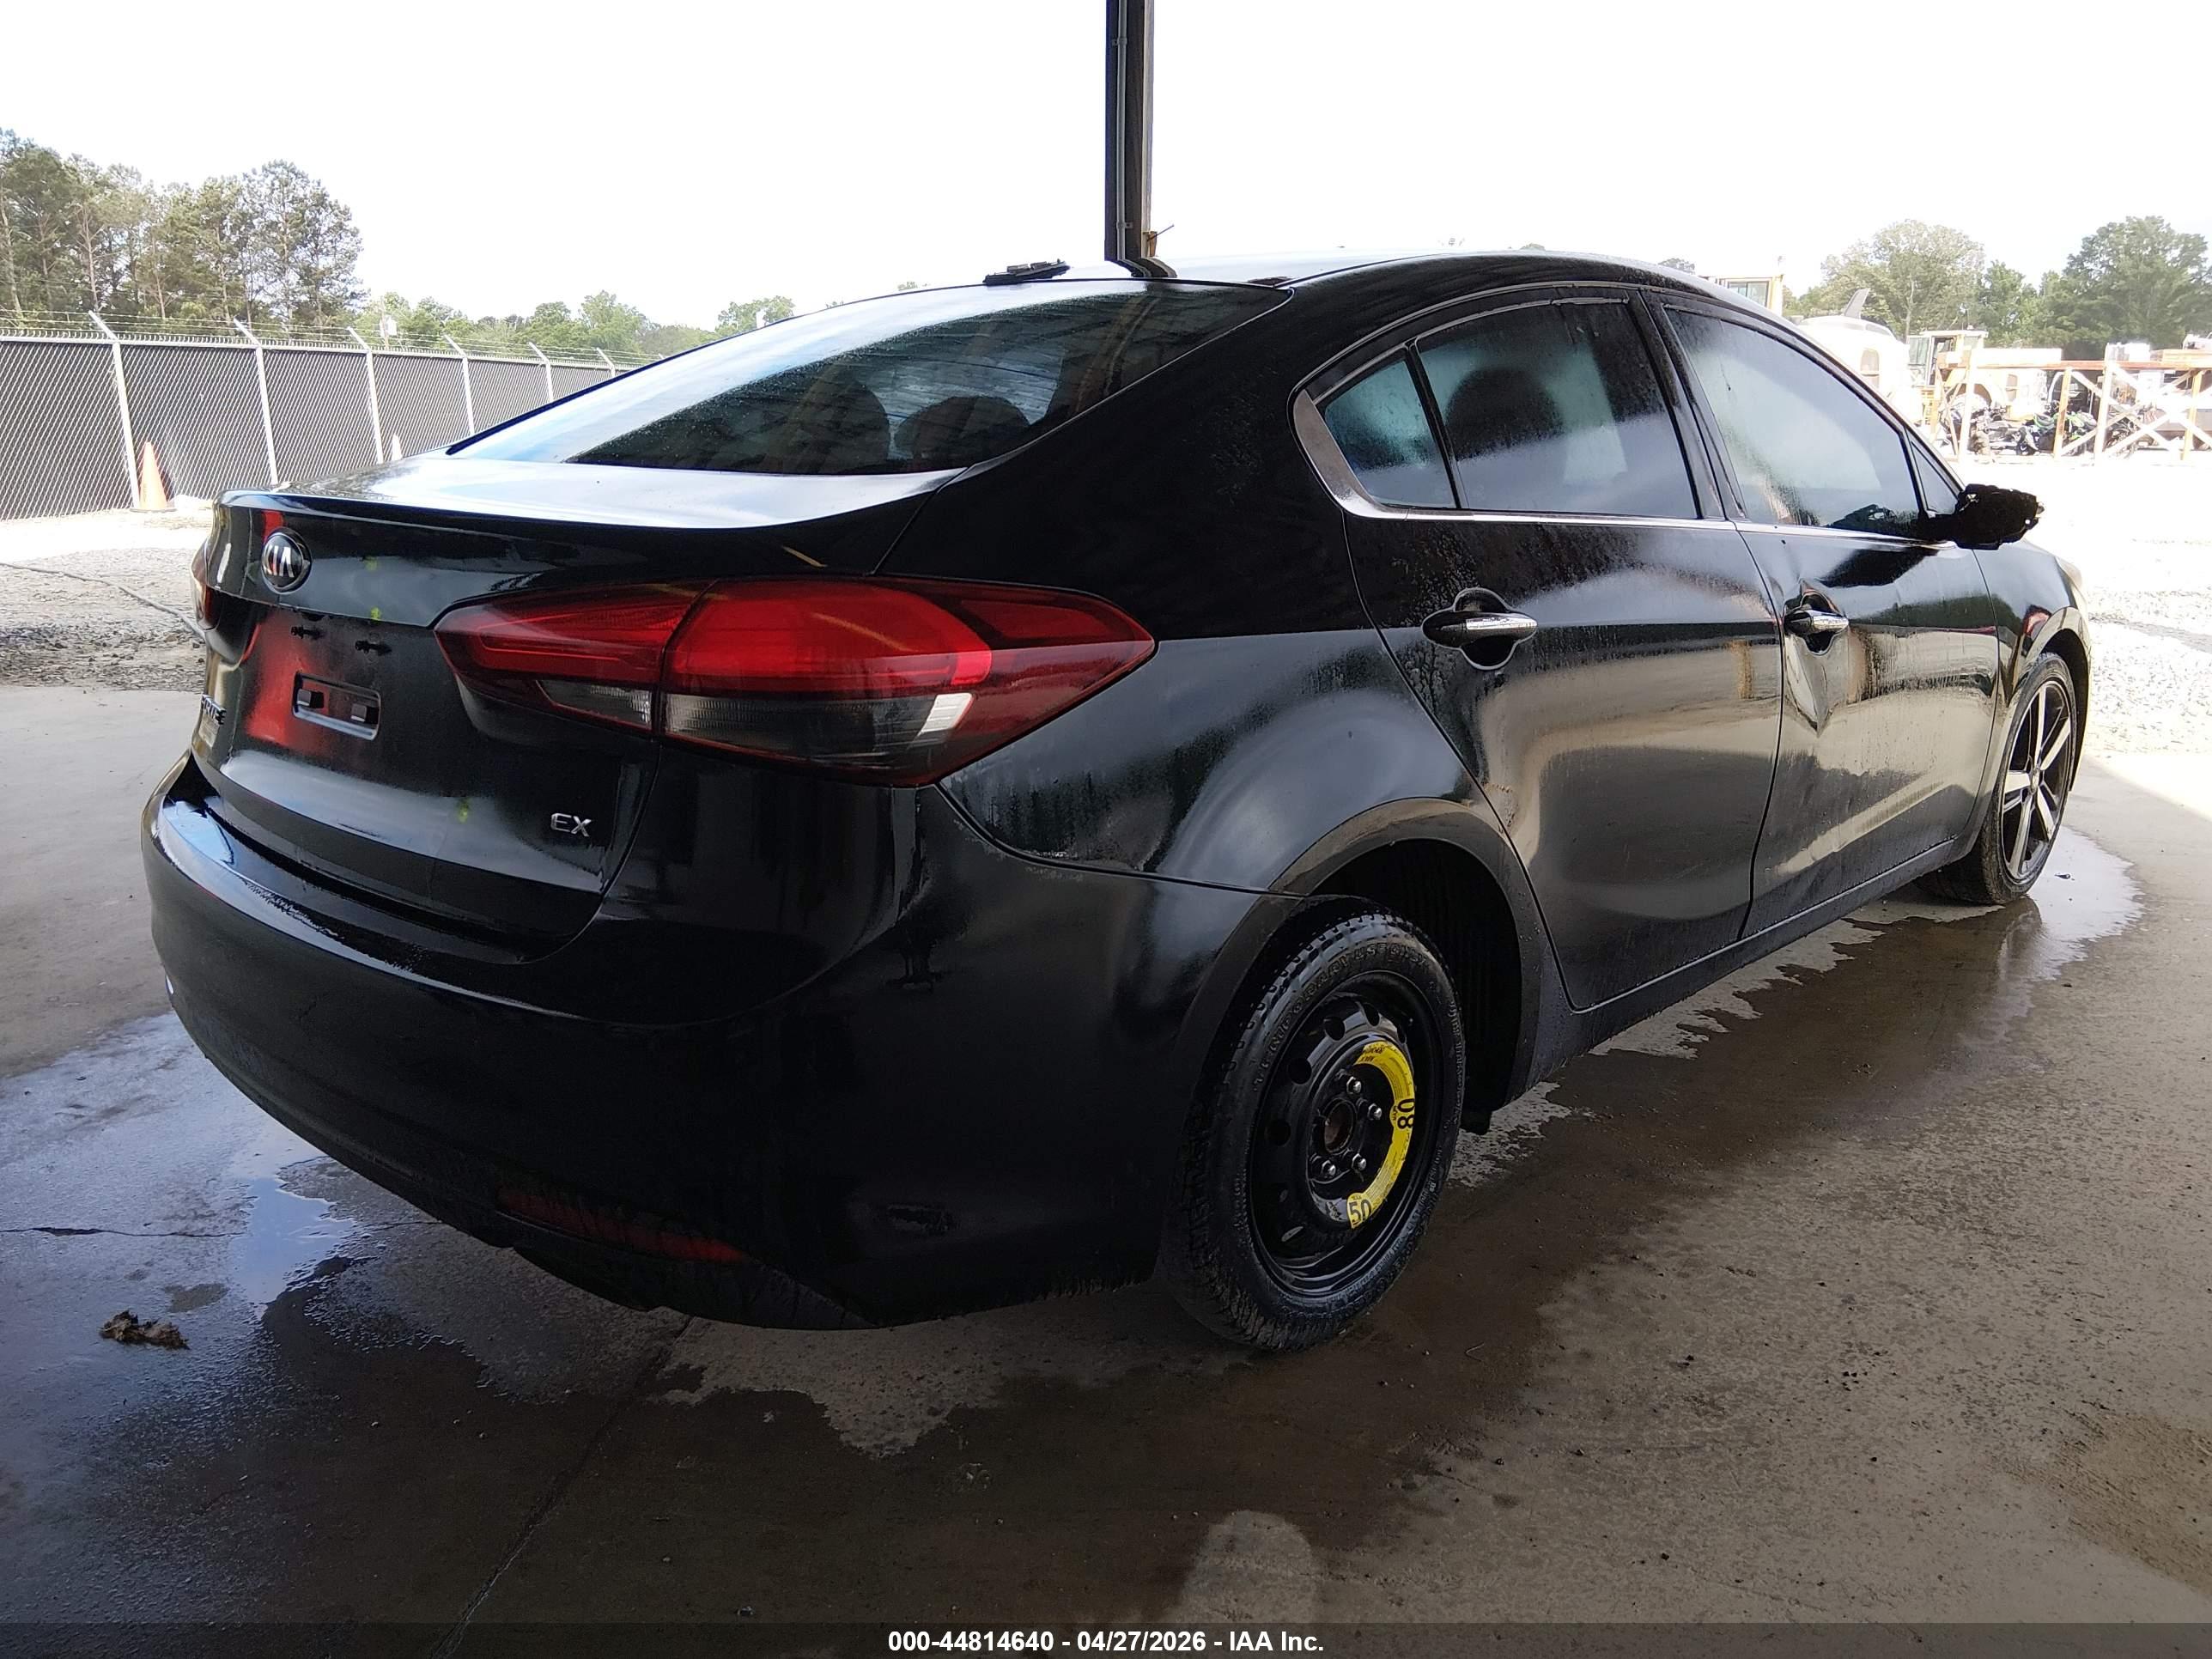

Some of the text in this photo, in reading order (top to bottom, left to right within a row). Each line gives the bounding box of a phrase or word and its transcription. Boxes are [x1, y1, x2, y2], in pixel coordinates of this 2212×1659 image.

[550, 812, 592, 837] EX
[1396, 1097, 1415, 1130] 80
[1348, 1199, 1372, 1226] 50
